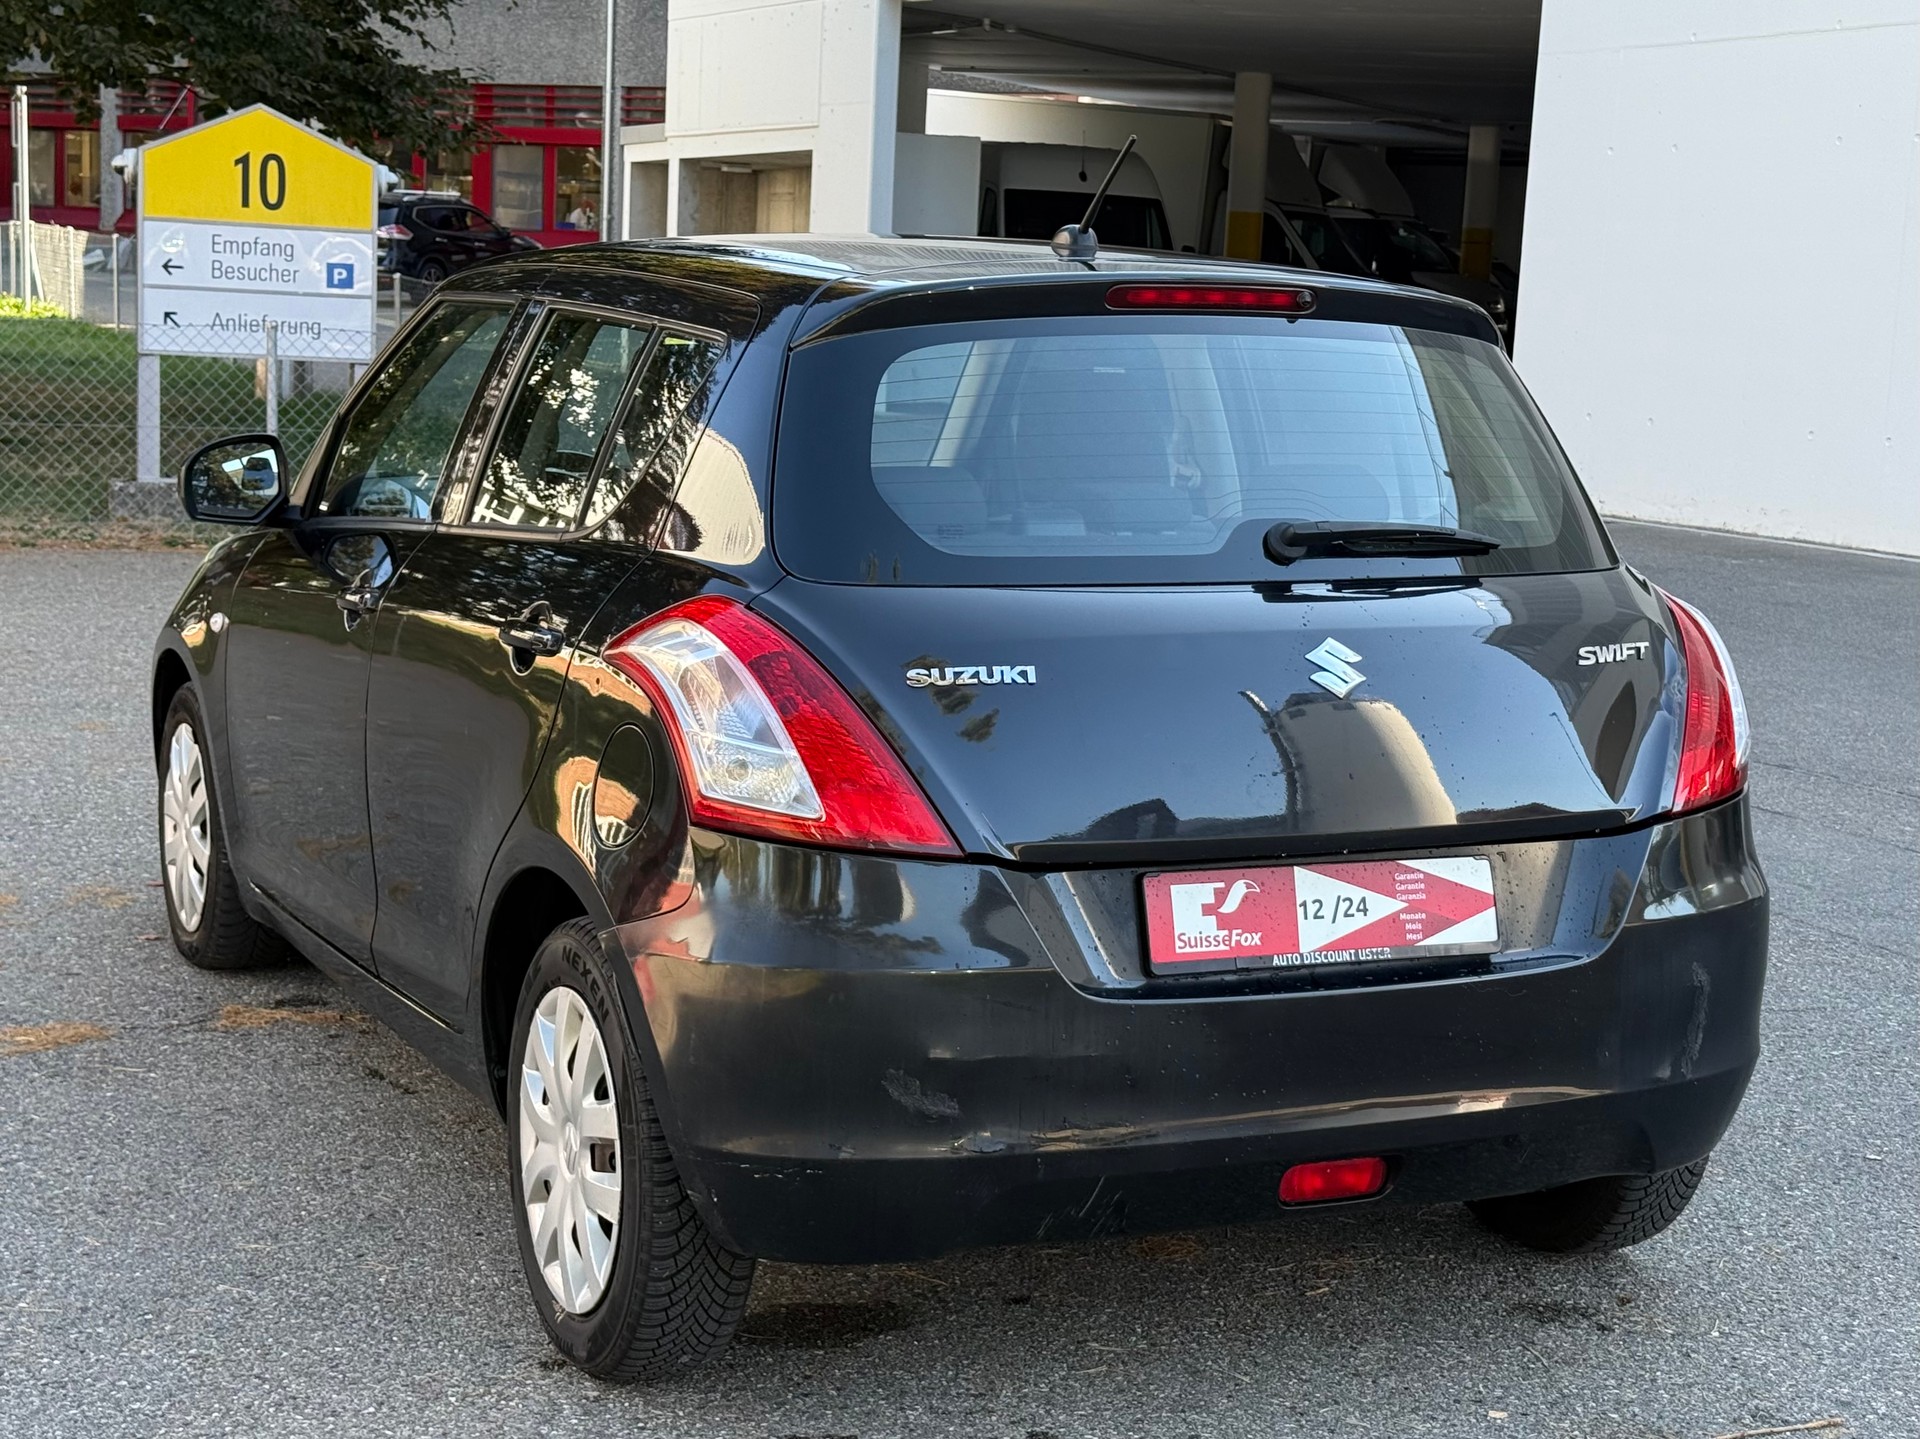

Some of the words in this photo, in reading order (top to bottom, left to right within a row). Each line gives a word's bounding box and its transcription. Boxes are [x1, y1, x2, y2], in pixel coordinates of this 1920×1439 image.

[234, 151, 287, 211] 10
[211, 233, 295, 262] Empfang
[210, 259, 300, 284] Besucher
[332, 267, 349, 285] P
[1578, 641, 1650, 666] SWIFT
[906, 665, 1037, 688] SUZUKI
[1394, 871, 1425, 881] Garantie
[1395, 881, 1426, 891] Garantie
[1396, 891, 1427, 901] Garanzia
[1298, 898, 1325, 921] 12
[1399, 912, 1427, 921] Monate
[1405, 921, 1423, 931] Mois
[1406, 931, 1423, 941] Mesi
[1272, 952, 1301, 967] AUTO
[1302, 948, 1357, 965] DISCOUNT
[1358, 946, 1392, 961] USTER
[561, 944, 610, 1024] NEXEN
